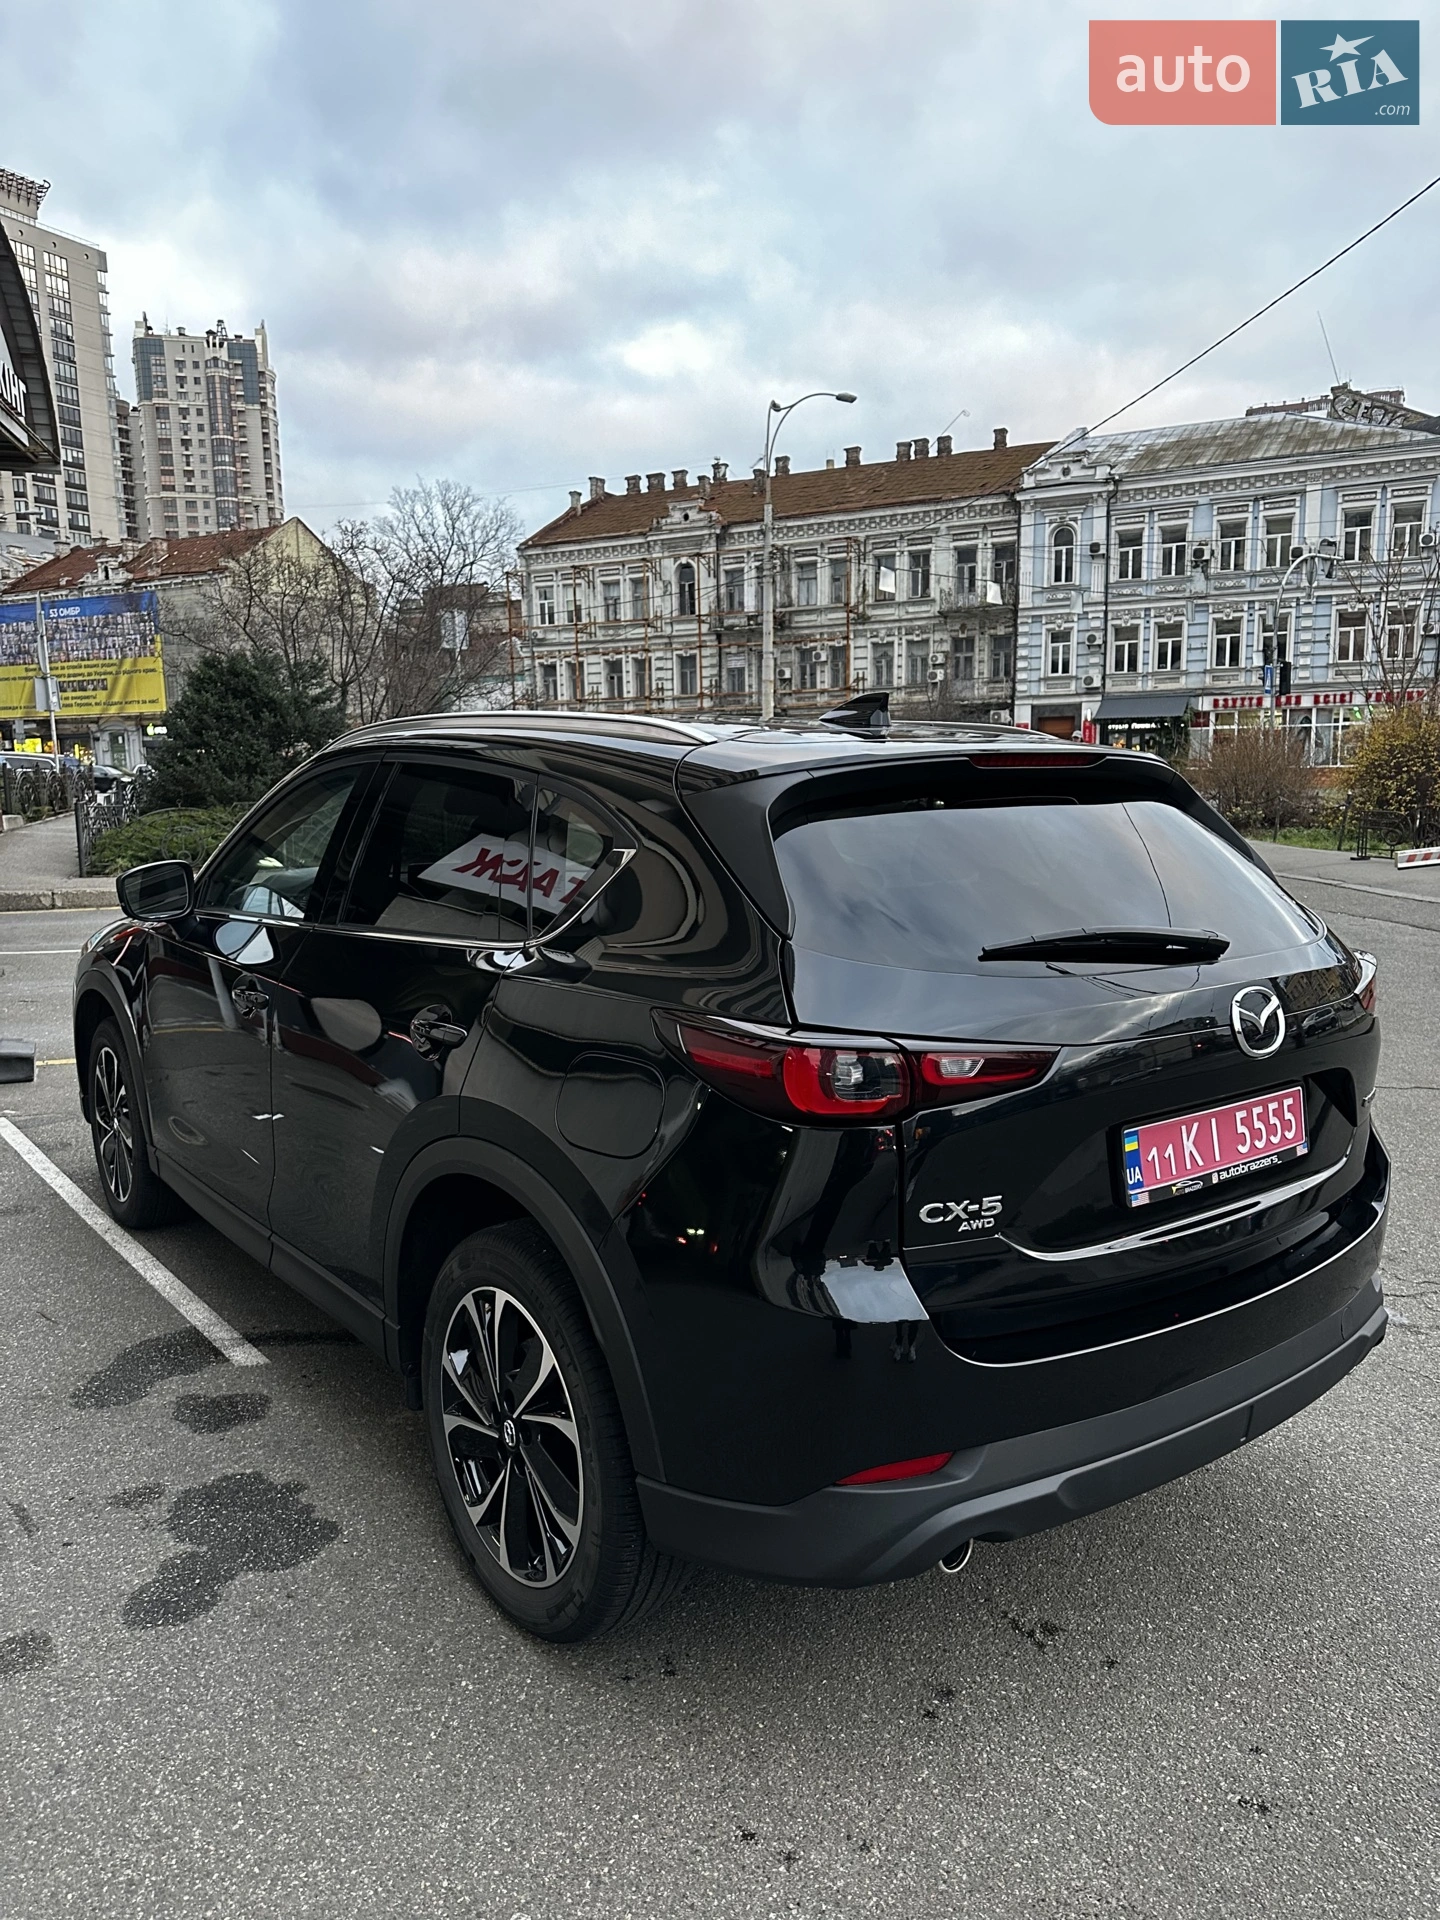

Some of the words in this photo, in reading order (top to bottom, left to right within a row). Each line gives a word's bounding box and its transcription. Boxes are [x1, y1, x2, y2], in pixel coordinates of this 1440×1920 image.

[49, 608, 58, 617] 53
[59, 606, 80, 616] ОМБР
[1235, 1097, 1297, 1155] 5555
[1127, 1168, 1143, 1185] UA
[919, 1195, 1003, 1224] CX-5
[958, 1217, 995, 1232] AWD
